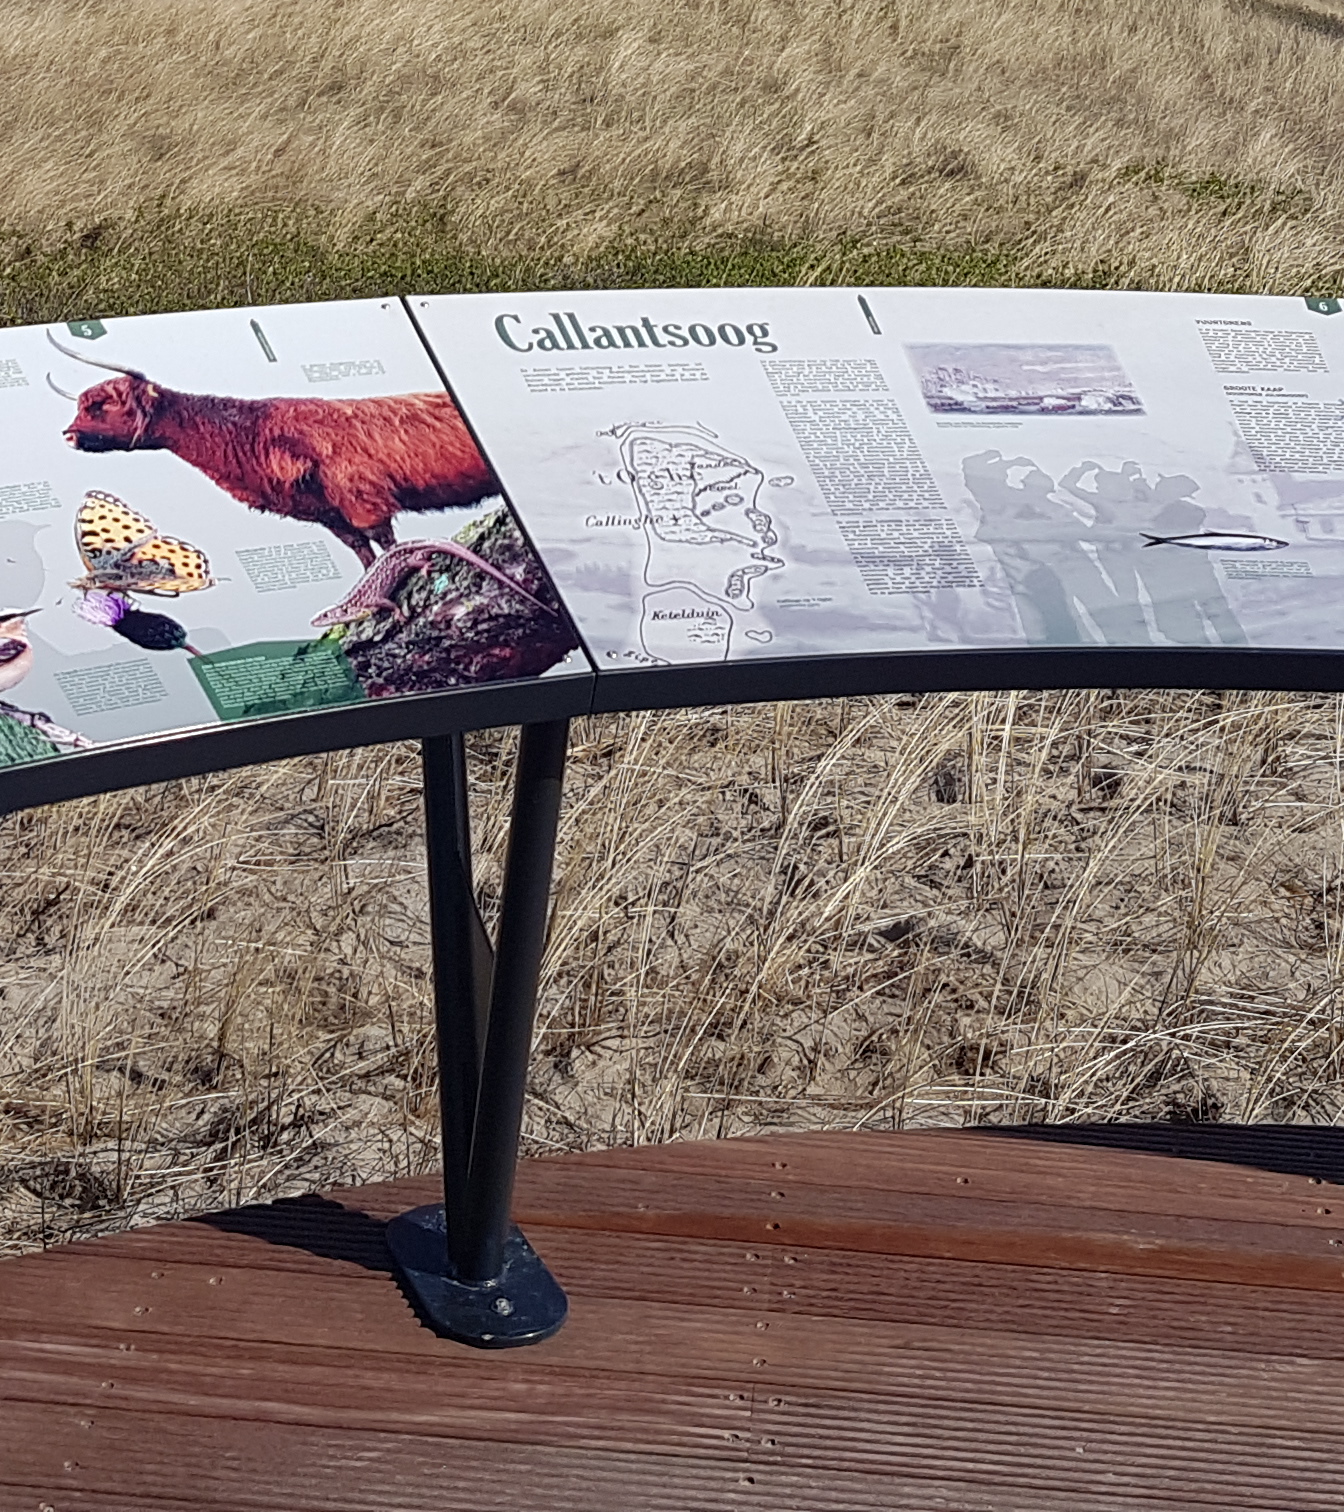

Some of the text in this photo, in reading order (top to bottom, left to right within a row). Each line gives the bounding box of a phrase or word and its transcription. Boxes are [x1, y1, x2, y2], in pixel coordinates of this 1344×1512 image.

[1318, 301, 1329, 312] 6
[81, 324, 93, 336] 5
[494, 312, 778, 353] Callantsoog
